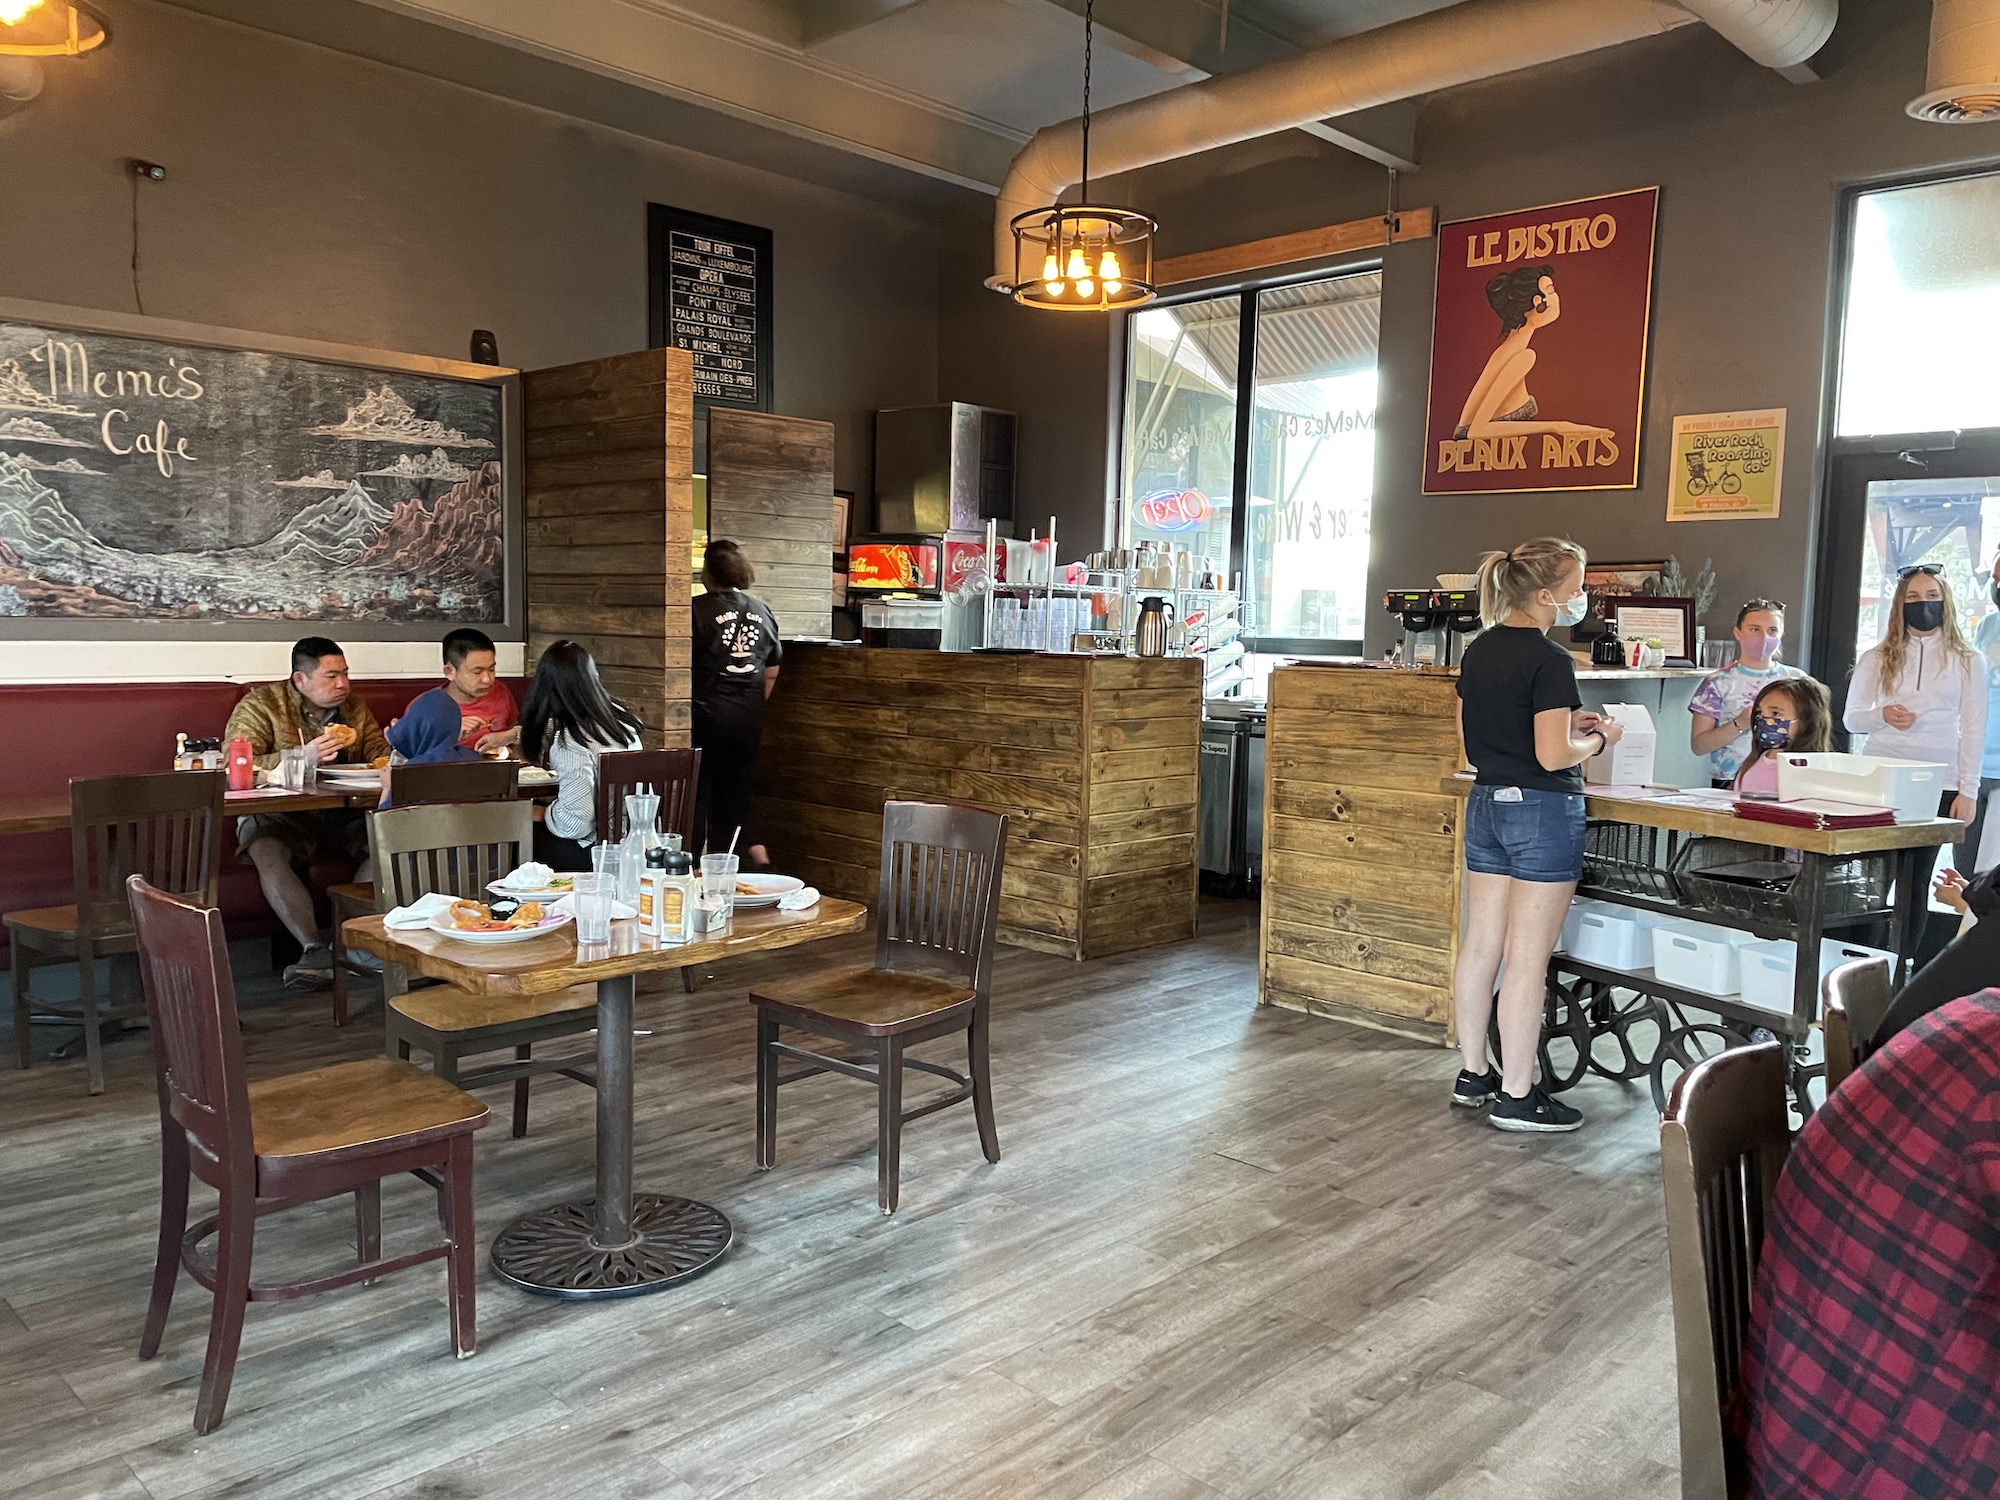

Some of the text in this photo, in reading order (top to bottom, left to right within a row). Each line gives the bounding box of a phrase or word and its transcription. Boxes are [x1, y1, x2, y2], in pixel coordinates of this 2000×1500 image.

[694, 238, 735, 257] TOUR EIFFEL
[1466, 213, 1617, 268] LE BISTRO
[673, 250, 753, 274] JARDINS LUXEMBOURG
[688, 295, 737, 313] PONT NEUF
[675, 307, 704, 321] PALAIS
[706, 313, 732, 326] ROYAL
[676, 323, 752, 344] GRANDS BOULEVARDS
[692, 340, 722, 353] MICHEL
[694, 353, 704, 365] RE
[721, 357, 743, 370] NORD
[693, 369, 718, 382] RMAIN
[1693, 432, 1764, 449] River Rock
[1437, 430, 1619, 473] BEAUX ARTS
[1708, 445, 1771, 467] Roasting
